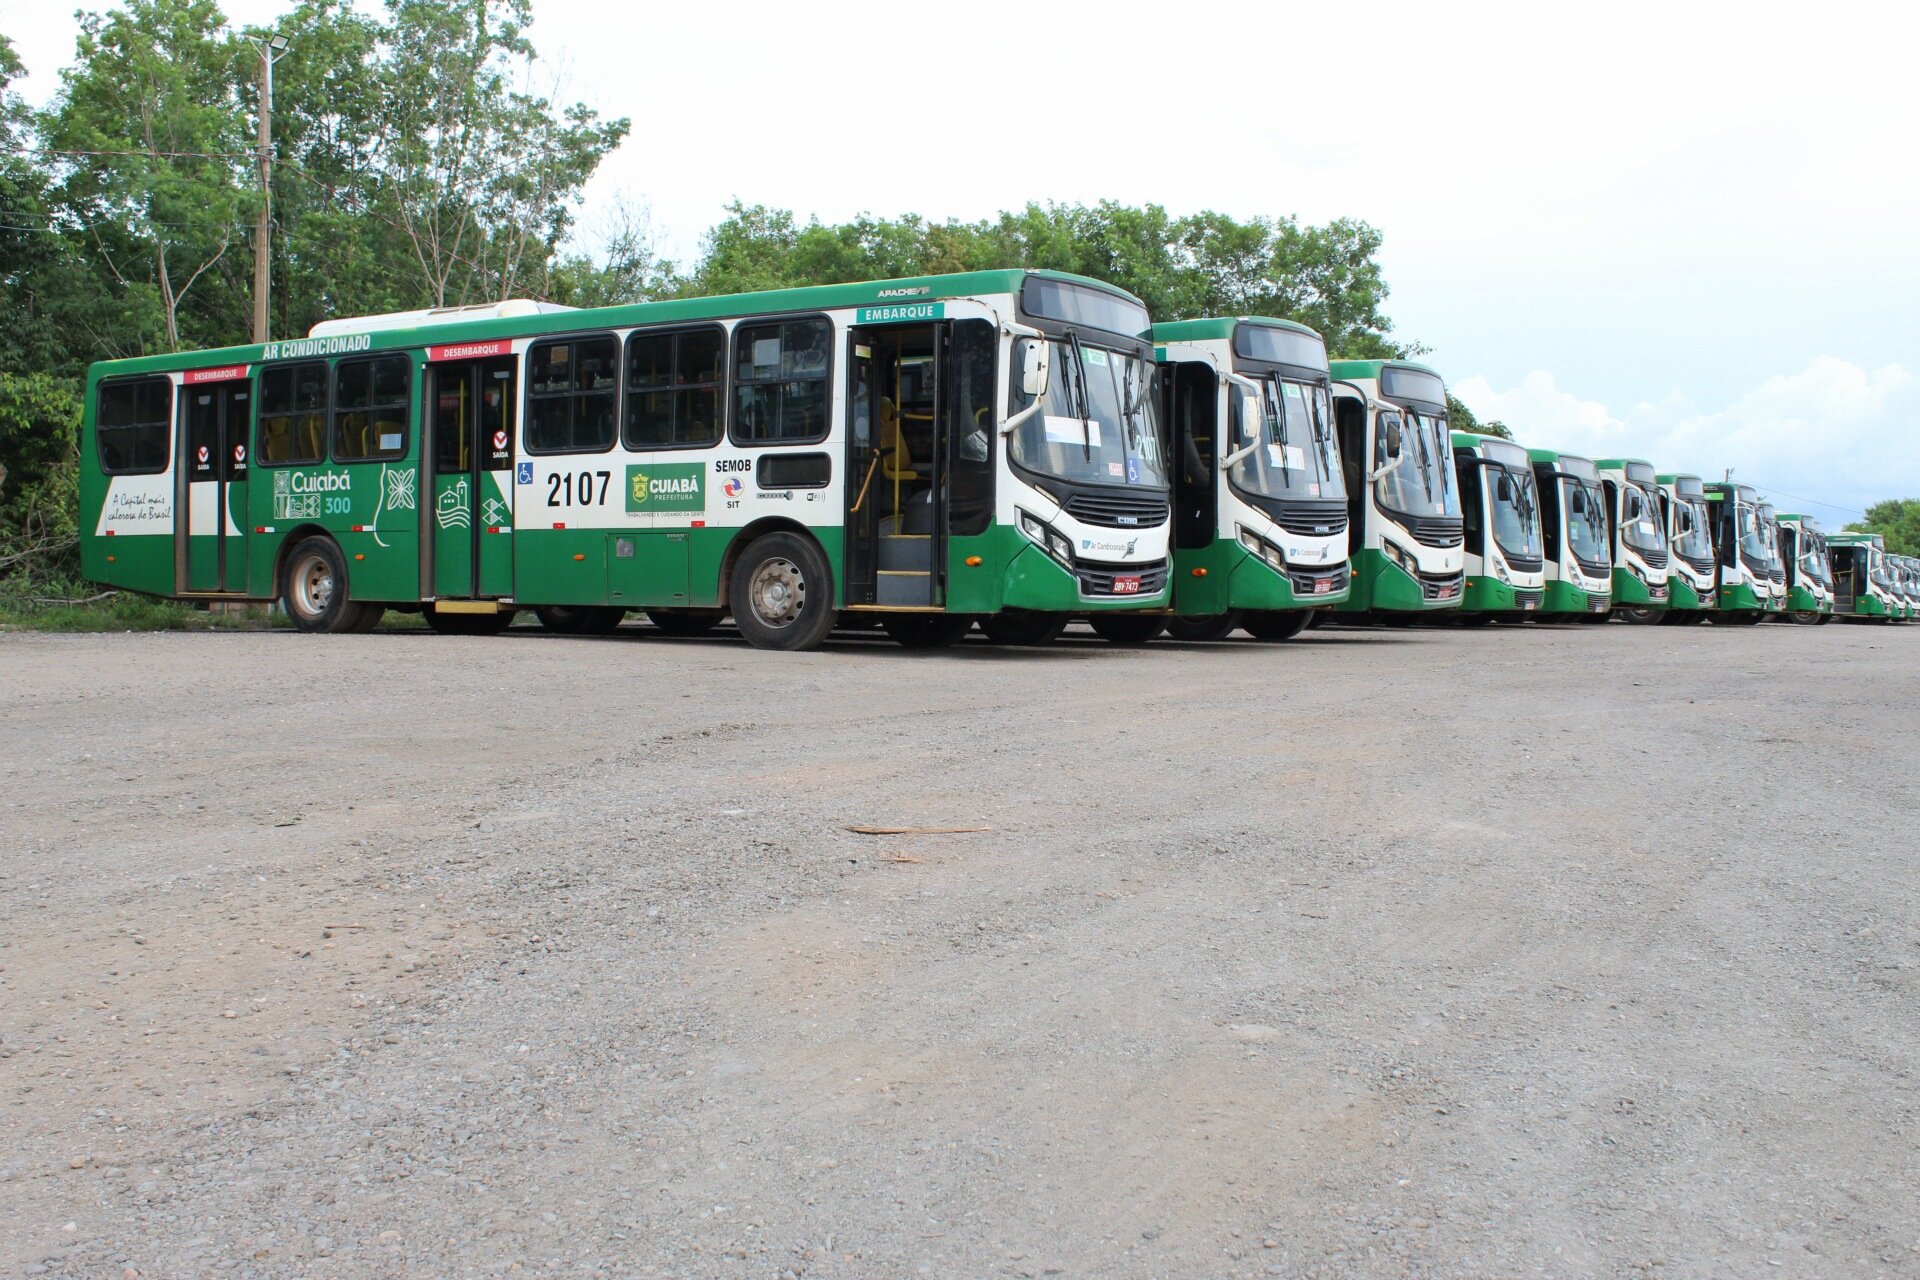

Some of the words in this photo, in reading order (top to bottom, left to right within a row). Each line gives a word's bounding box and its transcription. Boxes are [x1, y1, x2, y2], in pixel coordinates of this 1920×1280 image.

[865, 305, 933, 321] EMBARQUE
[262, 344, 278, 360] AR
[281, 334, 371, 358] CONDICIONADO
[443, 344, 499, 358] DESEMBARQUE
[194, 369, 238, 381] DESEMBARQUE
[1135, 434, 1157, 461] 2107
[715, 459, 752, 473] SEMOB
[291, 469, 351, 493] Cuiabá
[547, 471, 611, 507] 2107
[649, 474, 699, 494] CUIABÁ
[113, 493, 119, 506] A
[120, 492, 147, 509] Capital
[148, 494, 165, 505] mais
[325, 496, 351, 514] 300
[654, 493, 693, 501] PREFEITURA
[727, 500, 740, 509] SIT
[108, 507, 136, 520] calorosa
[148, 505, 171, 520] Brasil
